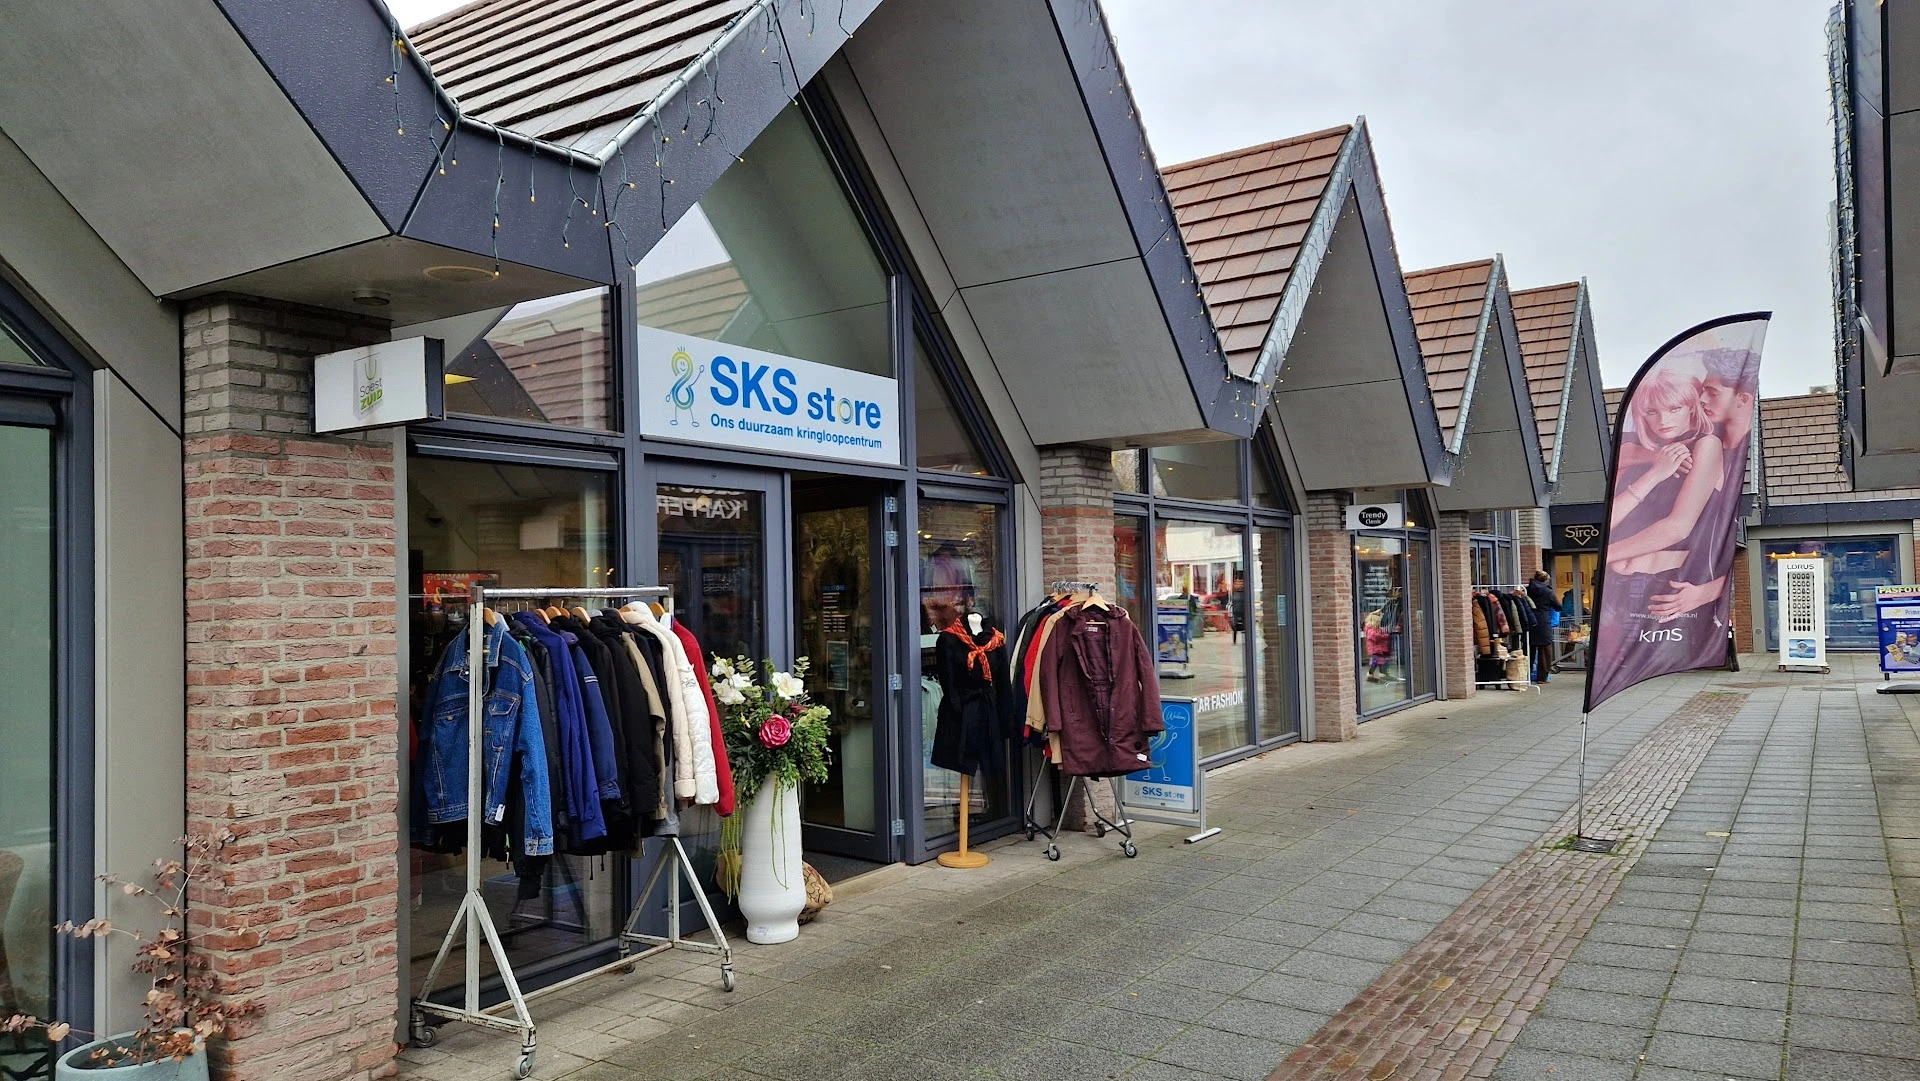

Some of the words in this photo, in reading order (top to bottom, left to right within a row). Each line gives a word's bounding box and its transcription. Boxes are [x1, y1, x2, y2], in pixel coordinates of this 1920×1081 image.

[360, 378, 382, 398] Soest
[710, 355, 798, 416] SKS
[807, 387, 882, 429] store
[360, 388, 383, 411] ZUID
[711, 413, 735, 429] Ons
[738, 418, 794, 437] duurzaam
[797, 426, 882, 449] kringloopcentrum
[1361, 511, 1387, 520] Trendy
[1565, 524, 1600, 538] Sirco
[1197, 696, 1210, 713] AR
[1211, 690, 1243, 710] FASHION
[1142, 786, 1163, 797] SKS
[1164, 791, 1185, 799] store
